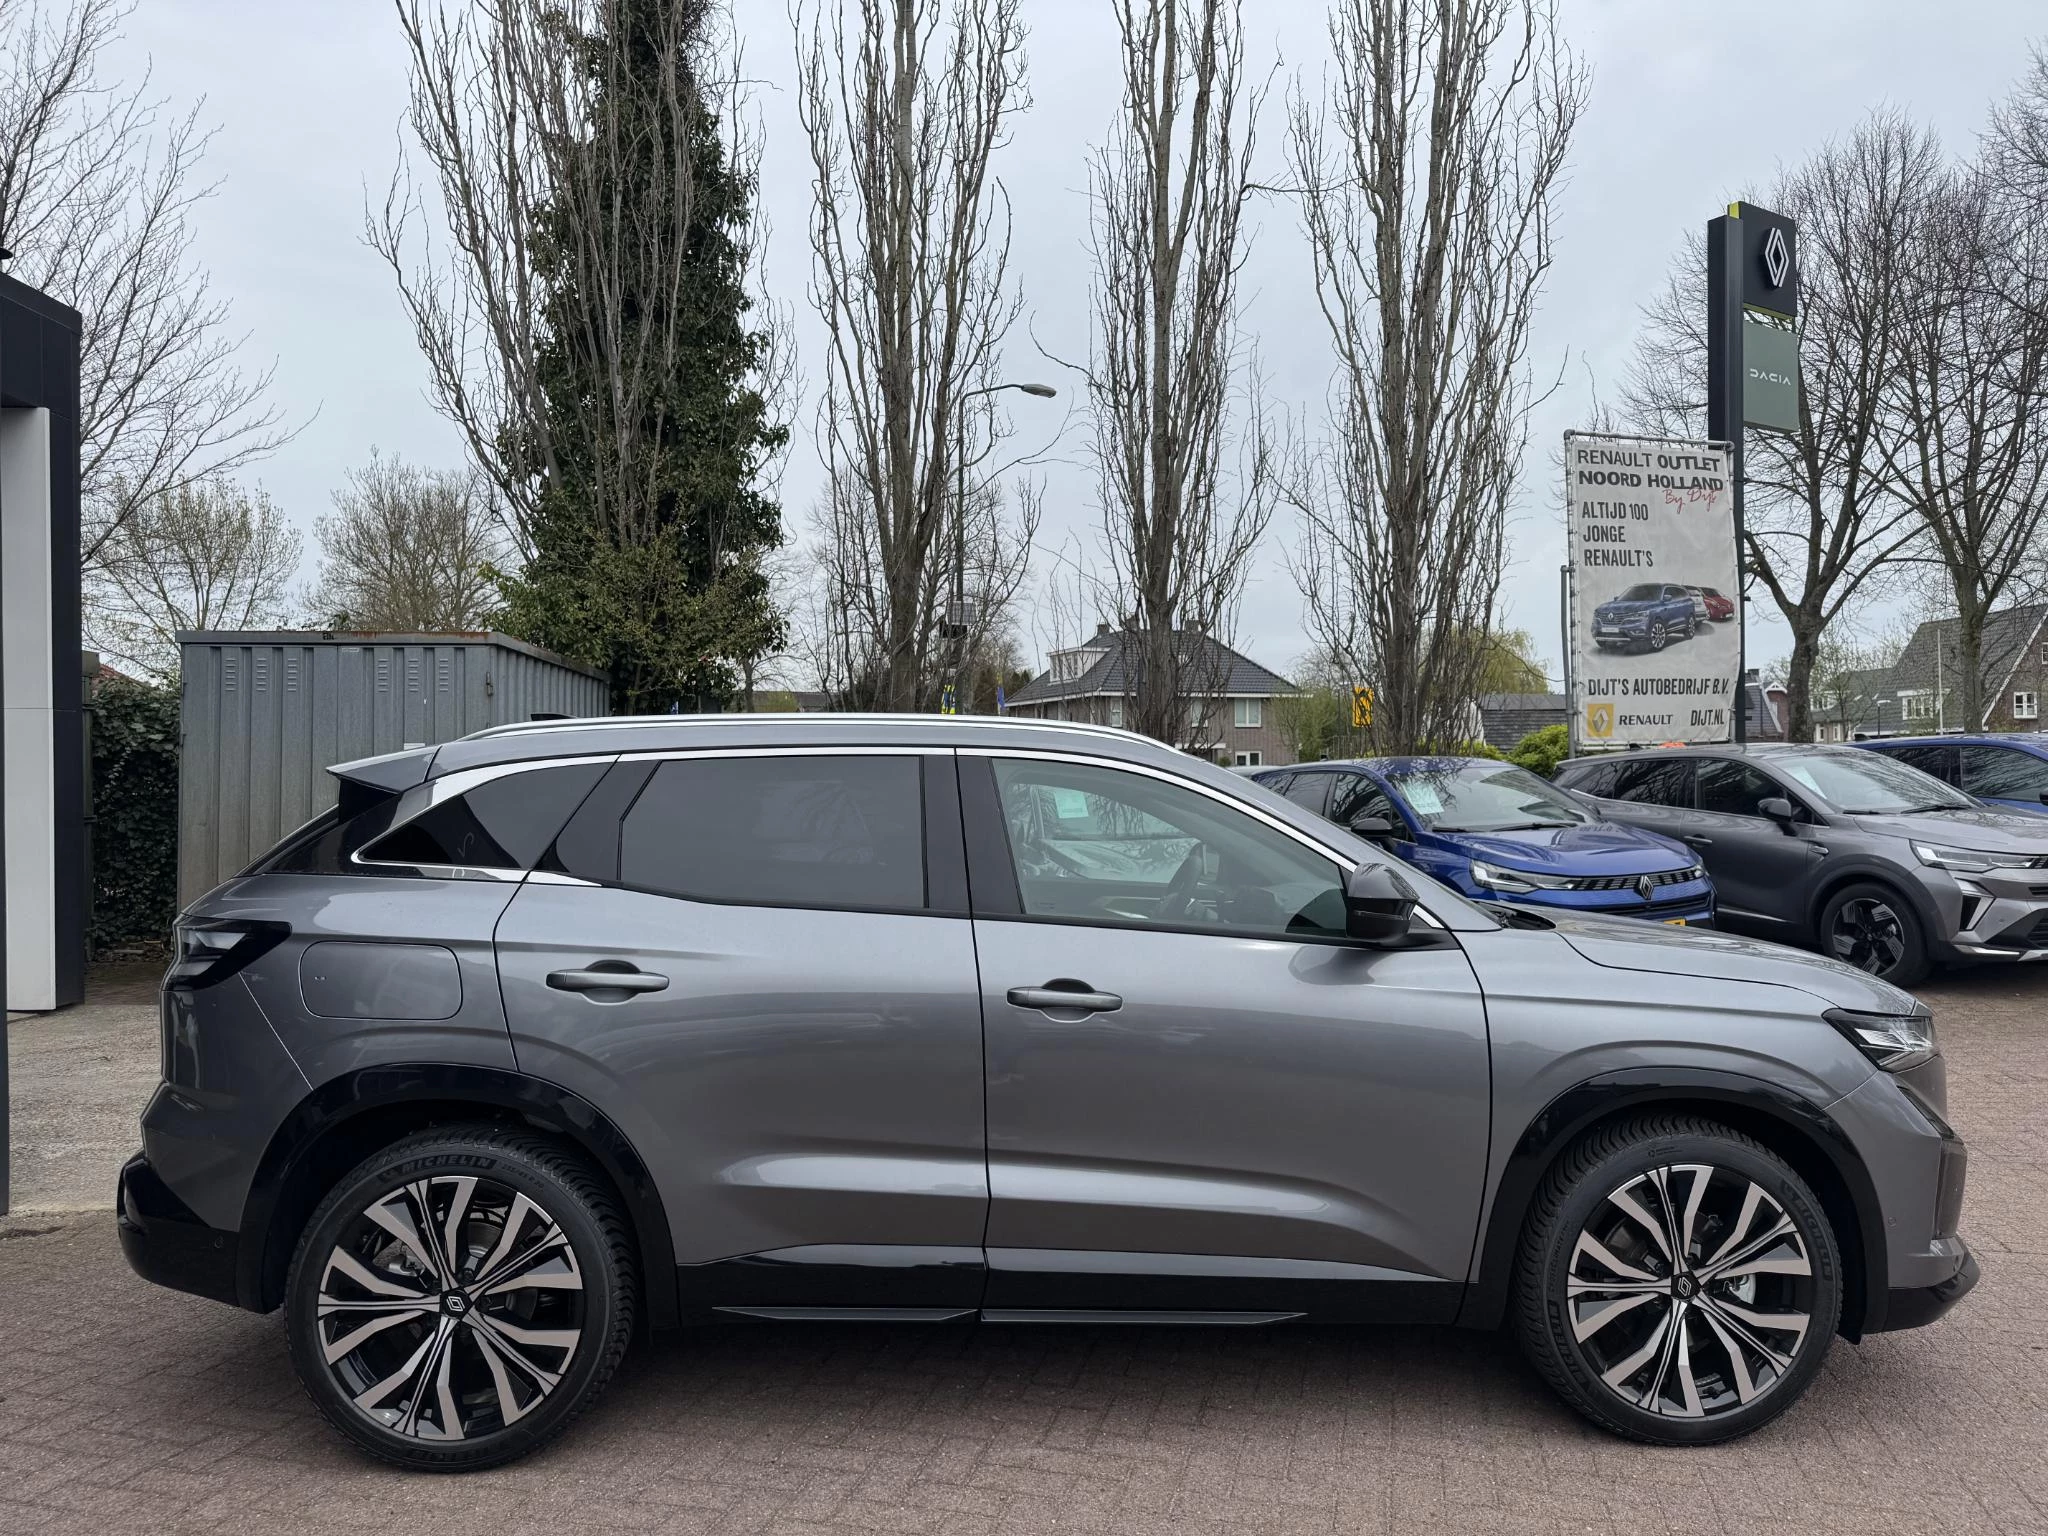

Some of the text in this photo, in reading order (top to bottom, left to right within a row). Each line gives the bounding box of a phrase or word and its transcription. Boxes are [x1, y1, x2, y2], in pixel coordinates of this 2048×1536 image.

[1749, 368, 1791, 386] DACIA
[1578, 449, 1720, 472] RENAULT OUTLET
[1579, 470, 1723, 491] NOORD HOLLAND
[1662, 488, 1686, 514] By
[1582, 501, 1649, 520] ALTIJD 100
[1583, 525, 1626, 543] JONGE
[1584, 549, 1653, 567] RENAULT'S
[1588, 678, 1729, 696] DIJT'S AUTOBEDRIJF B.V.
[1619, 714, 1673, 726] RENAULT
[1691, 709, 1724, 726] DIJT.NL
[401, 1155, 491, 1174] MICHELIN
